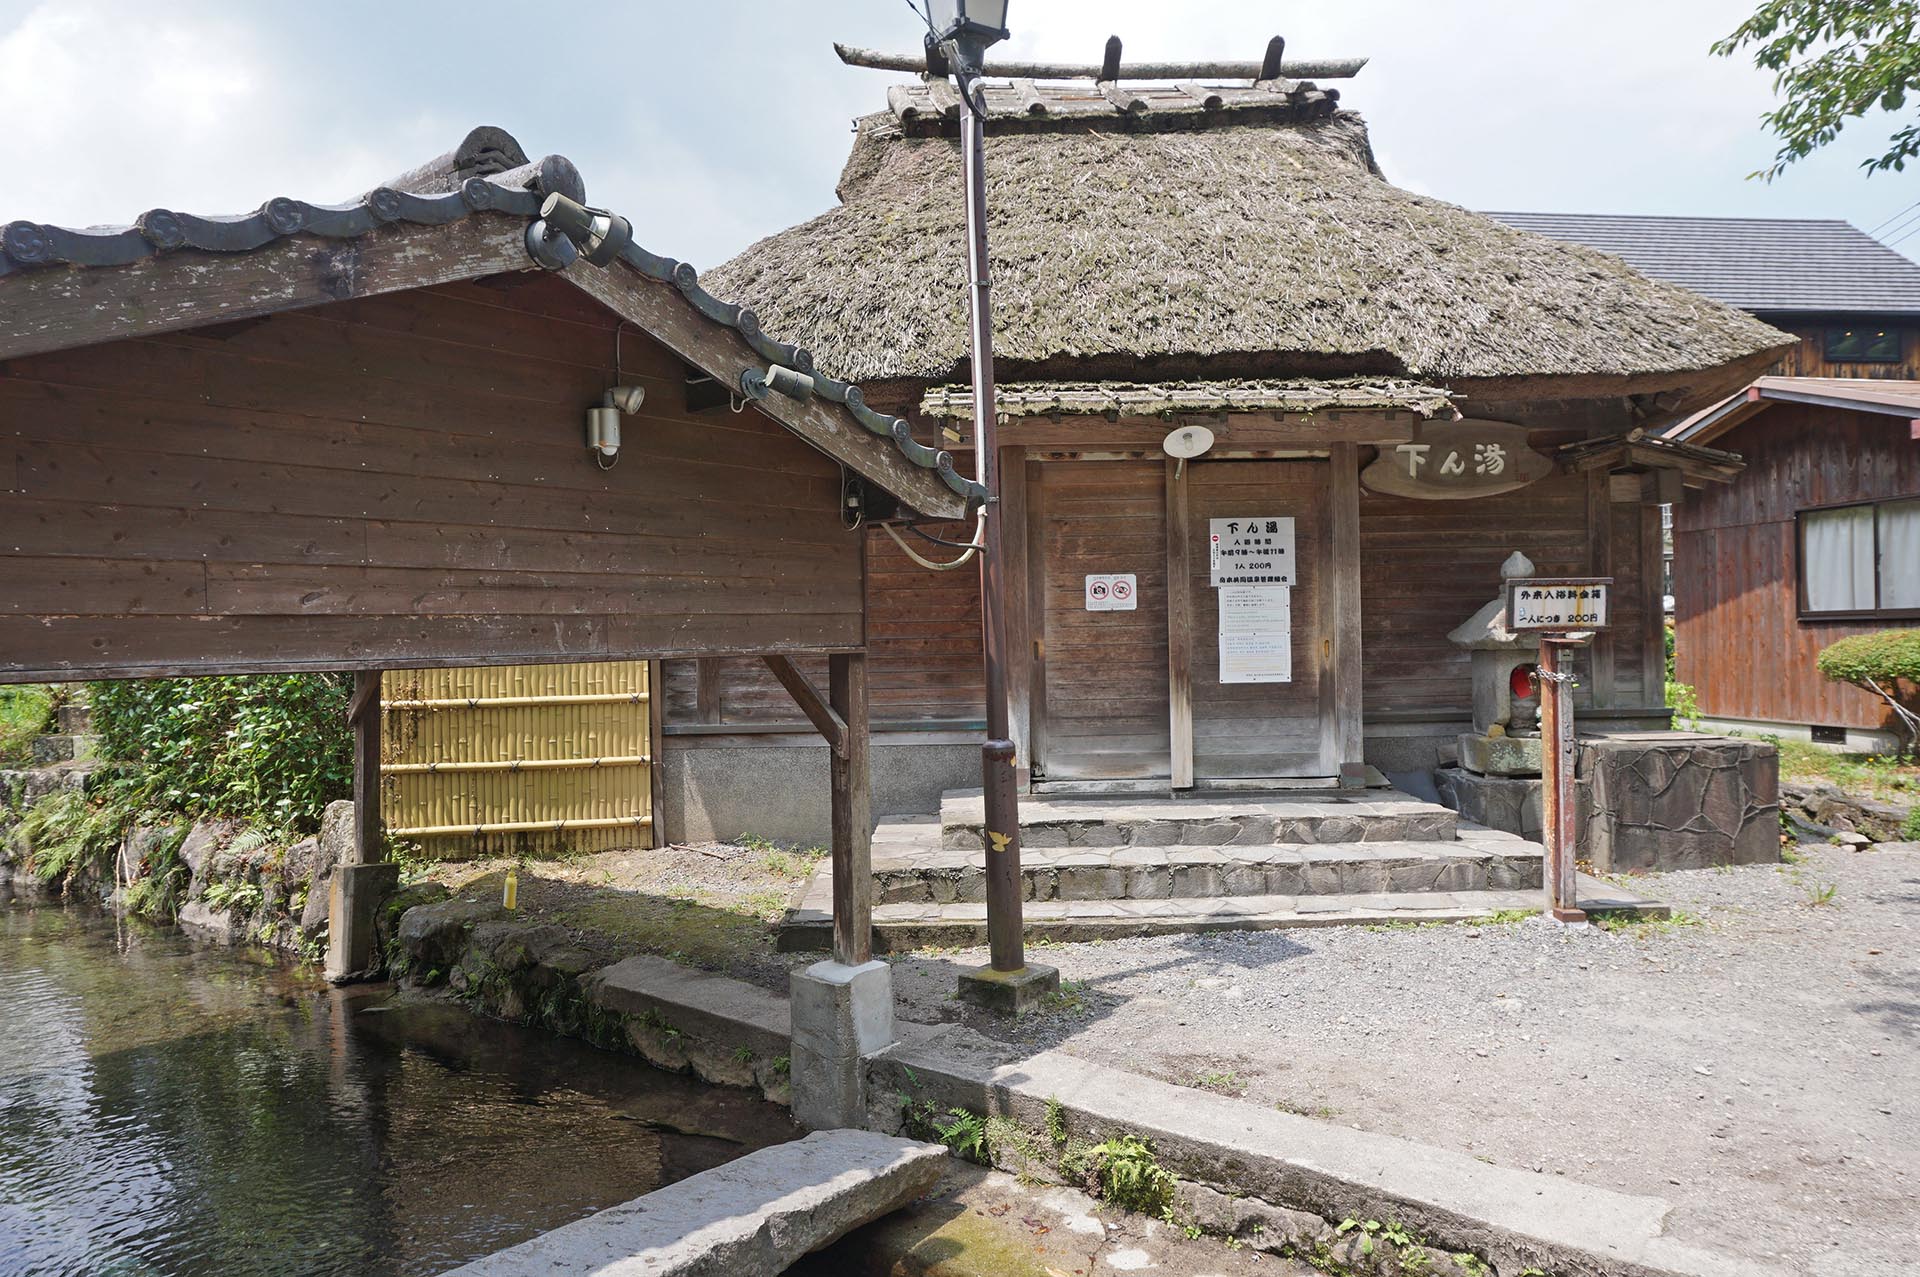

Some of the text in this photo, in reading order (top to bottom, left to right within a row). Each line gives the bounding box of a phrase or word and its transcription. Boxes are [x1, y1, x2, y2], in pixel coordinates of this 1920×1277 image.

[1396, 443, 1506, 479] 下ん湯
[1227, 521, 1278, 535] 下ん湯
[1249, 562, 1272, 570] 200円
[1520, 589, 1601, 600] 外来入浴料金箱
[1519, 613, 1598, 624] 一人につき 200円
